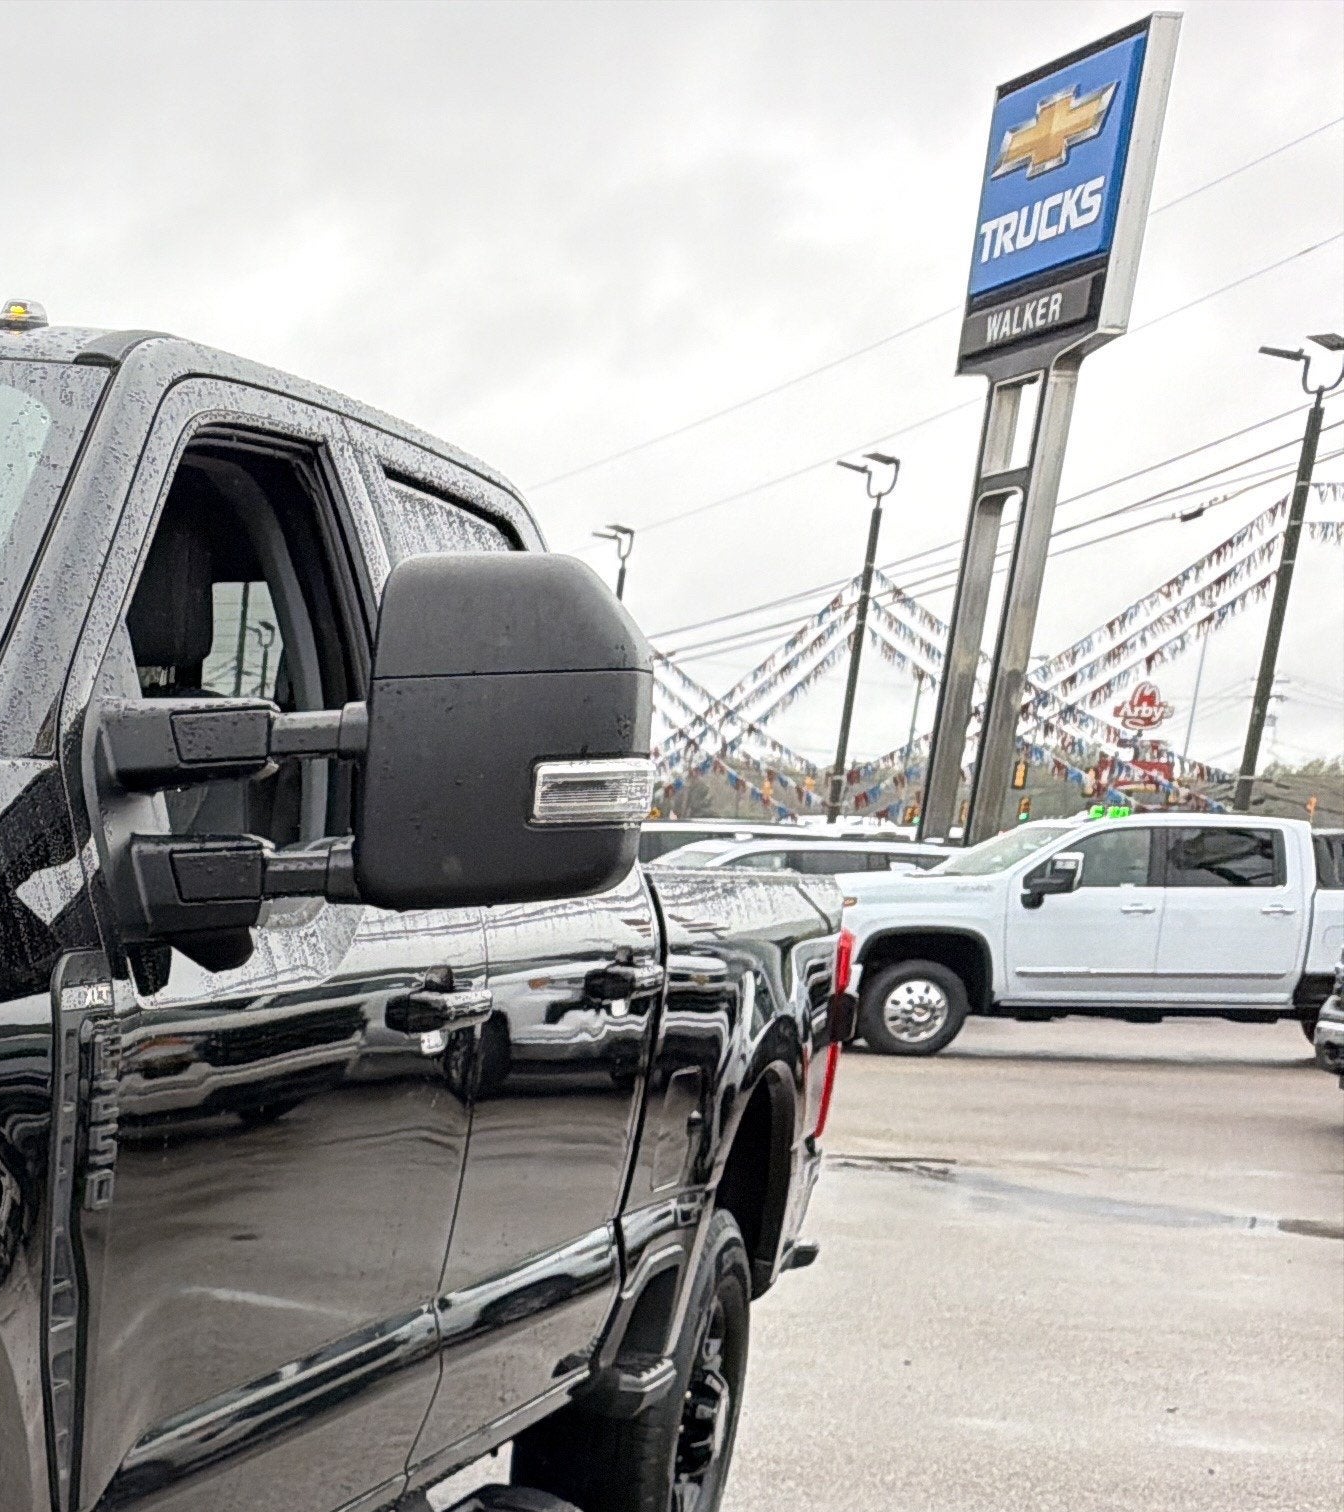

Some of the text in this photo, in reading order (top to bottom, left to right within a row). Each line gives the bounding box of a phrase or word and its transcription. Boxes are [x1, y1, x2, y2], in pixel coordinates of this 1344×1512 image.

[979, 175, 1106, 264] TRUCKS
[986, 292, 1063, 343] WALKER
[1119, 701, 1173, 722] Arby
